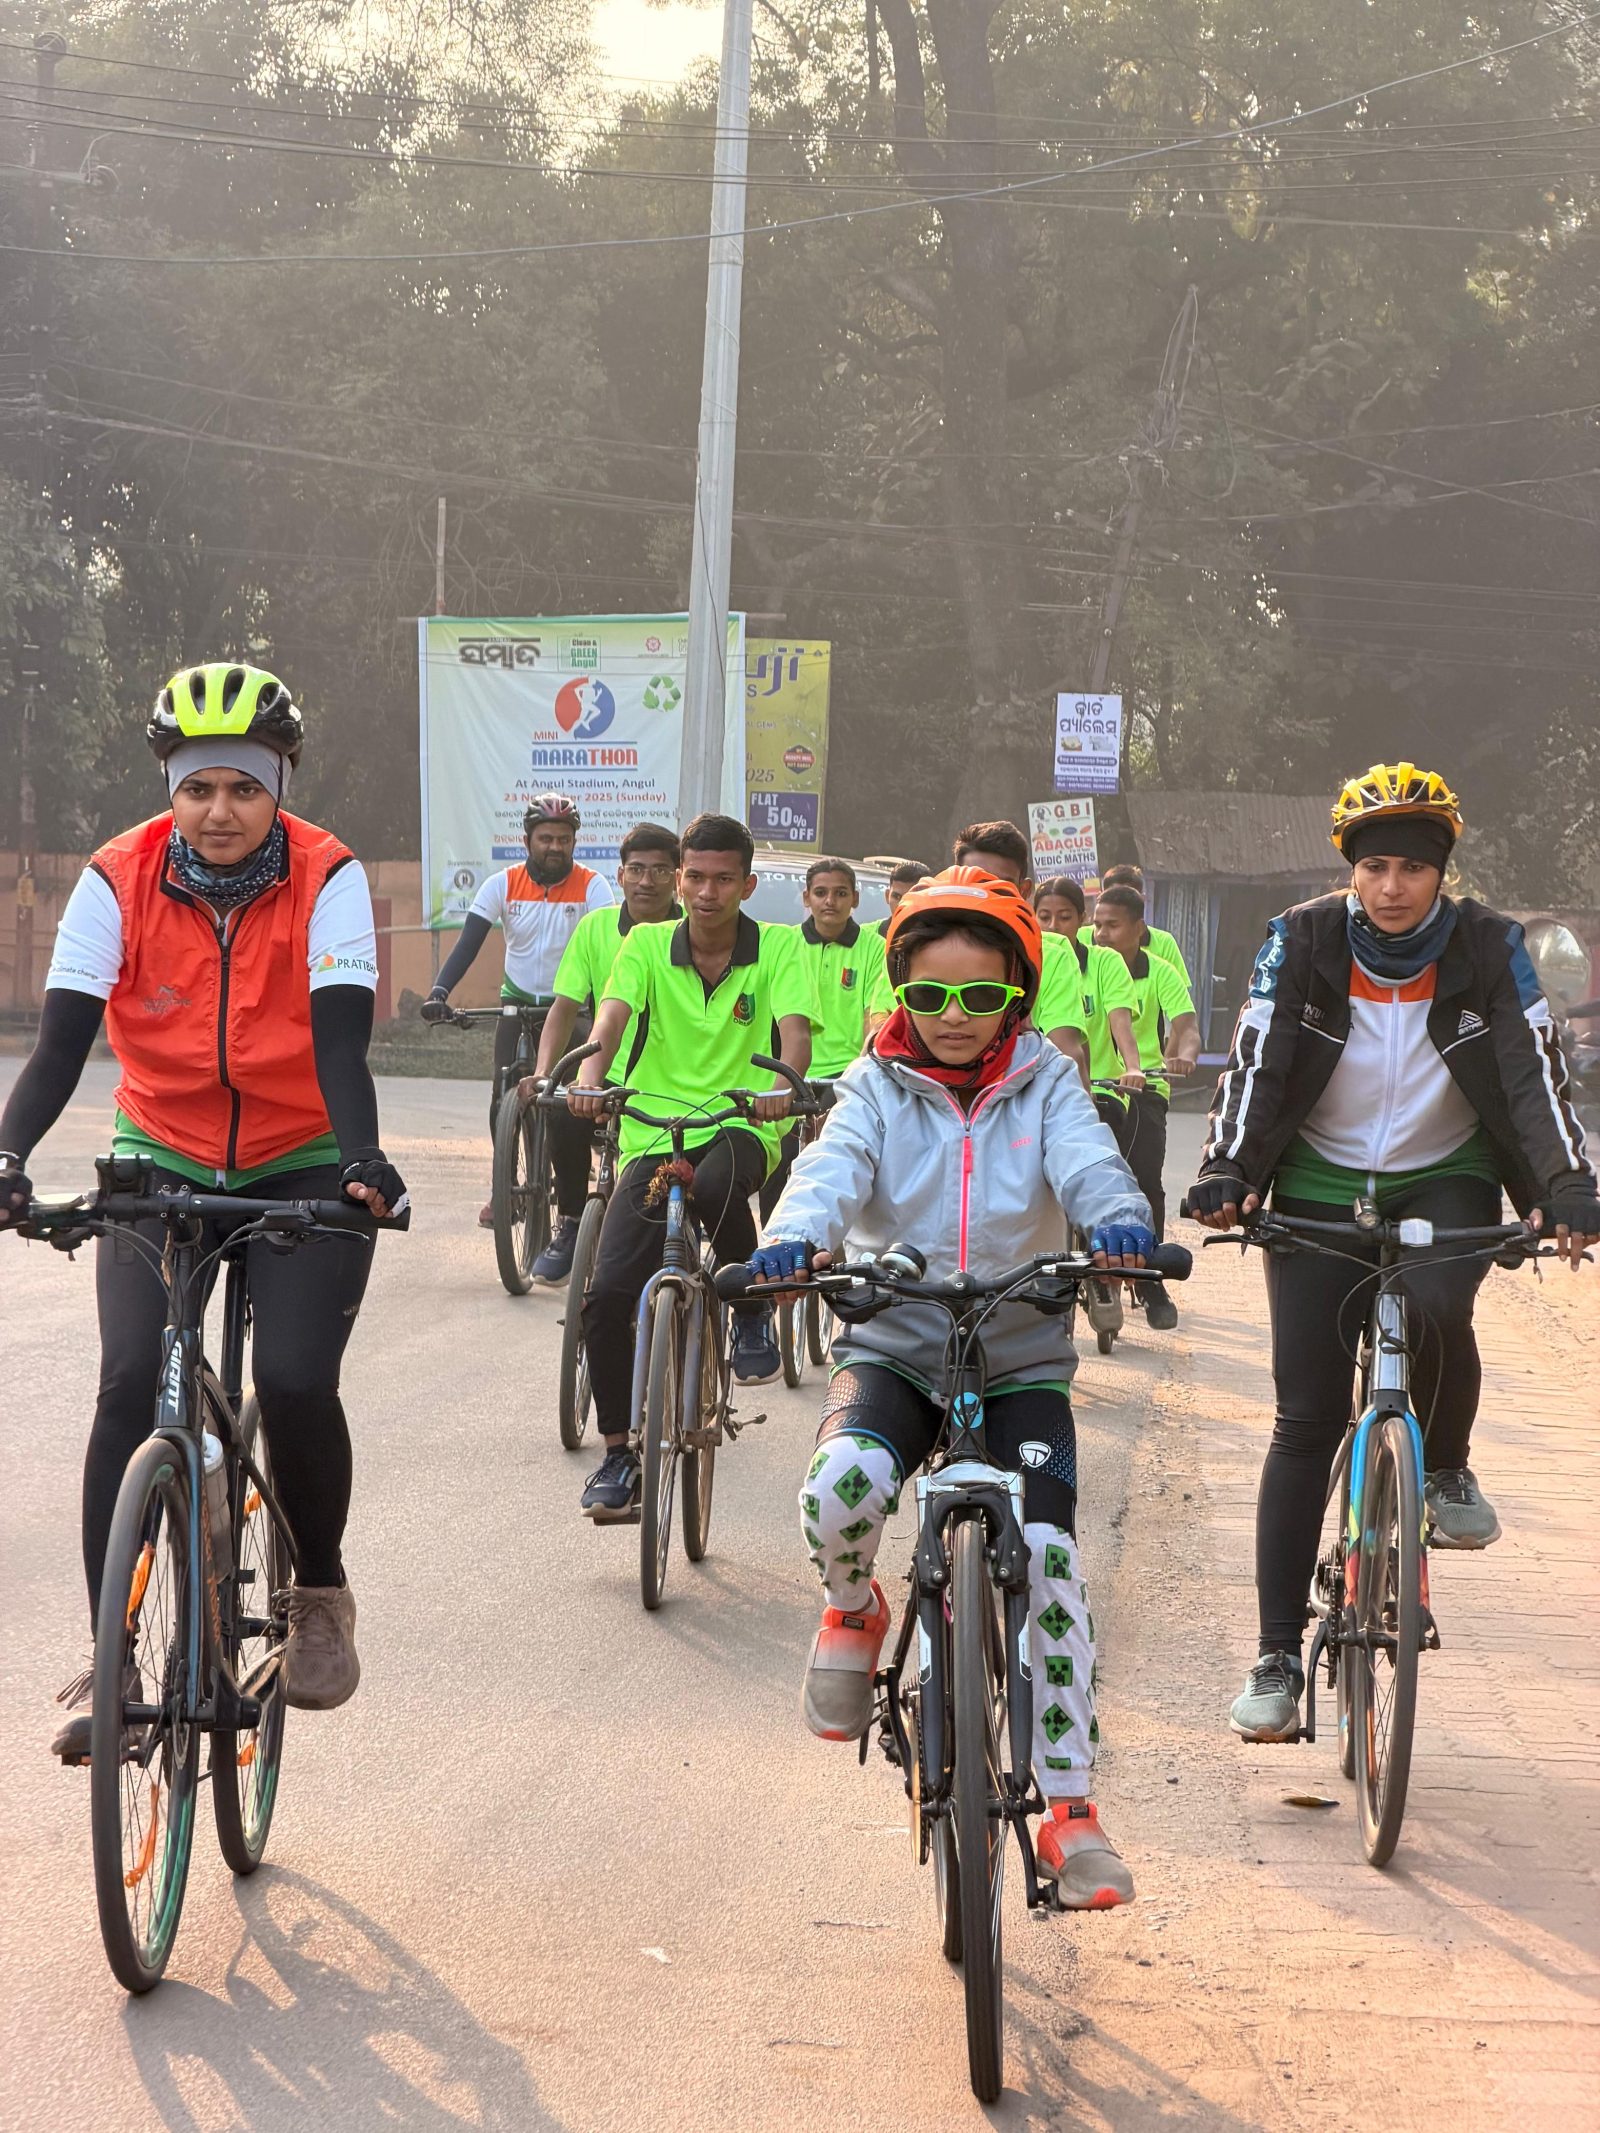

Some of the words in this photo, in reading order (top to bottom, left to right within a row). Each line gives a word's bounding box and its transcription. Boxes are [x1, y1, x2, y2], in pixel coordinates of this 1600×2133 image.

[571, 648, 598, 658] GREEN
[571, 658, 597, 668] Angul
[534, 731, 558, 740] MINI
[531, 748, 638, 766] MARATHON
[745, 768, 775, 782] 025
[515, 779, 528, 789] At
[531, 779, 564, 790] Angul
[567, 779, 619, 789] Stadium,
[622, 779, 655, 789] Angul
[584, 792, 613, 802] 2025
[616, 792, 667, 804] (Sunday)
[751, 793, 778, 806] FLAT
[767, 806, 807, 828] 50%
[789, 828, 814, 841] OFF
[1035, 836, 1093, 852] ABACUS
[1034, 855, 1062, 867] VEDIC
[1064, 852, 1096, 864] MATHS
[167, 1340, 183, 1416] GIANT
